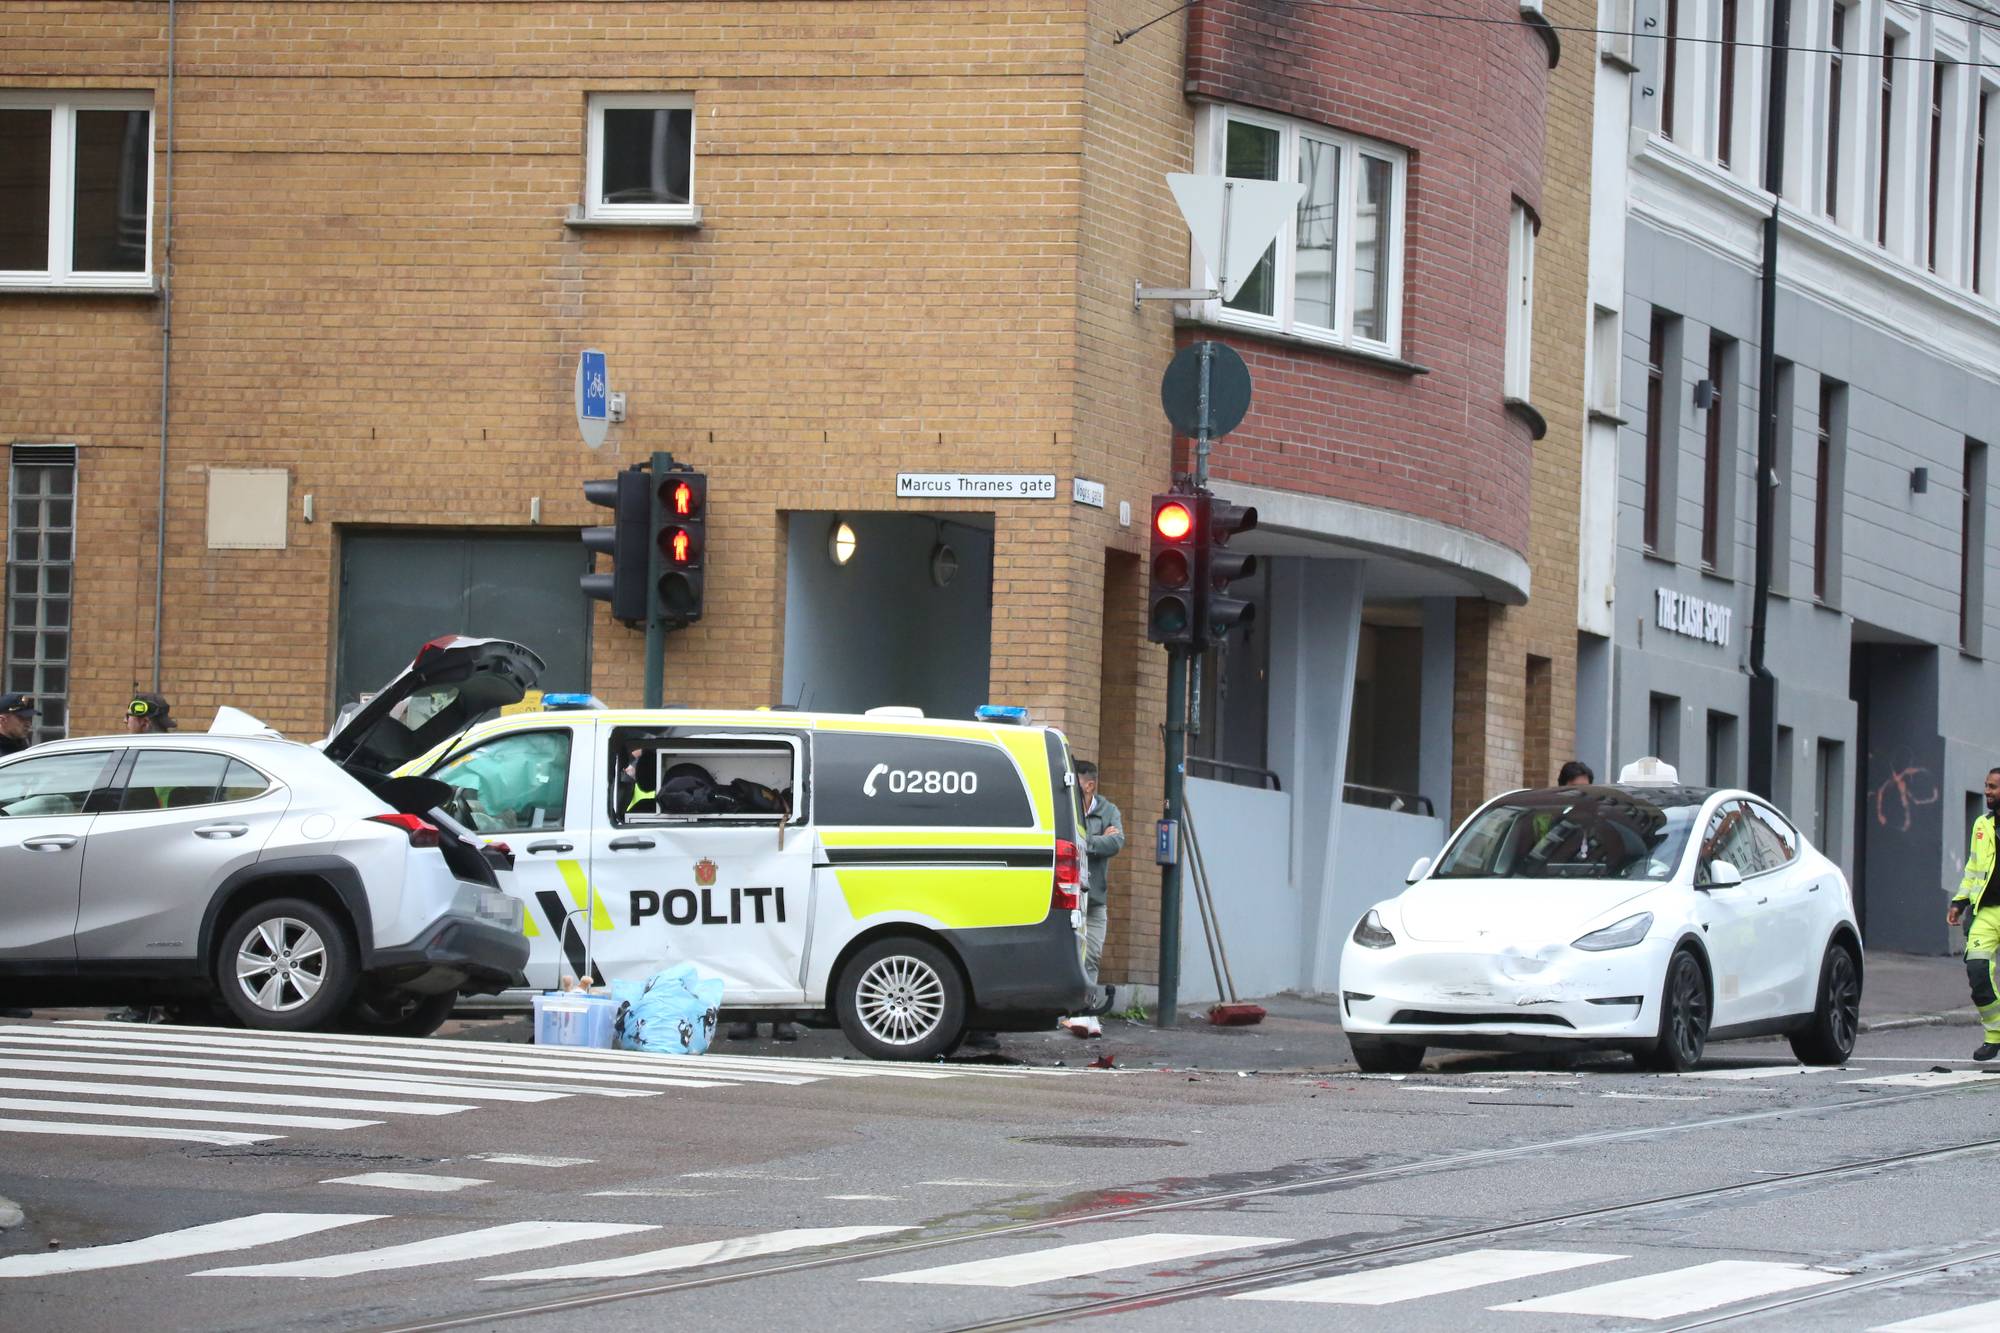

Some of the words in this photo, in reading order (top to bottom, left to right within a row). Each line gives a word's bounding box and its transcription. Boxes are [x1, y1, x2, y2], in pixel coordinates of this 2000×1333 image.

[901, 478, 951, 491] Marcus
[958, 478, 1013, 492] Thranes
[1019, 480, 1052, 495] gate
[1658, 587, 1678, 632] THE
[1678, 593, 1704, 639] LASH
[1705, 601, 1732, 646] SPOT
[888, 769, 978, 794] 02800
[629, 887, 786, 927] POLITI
